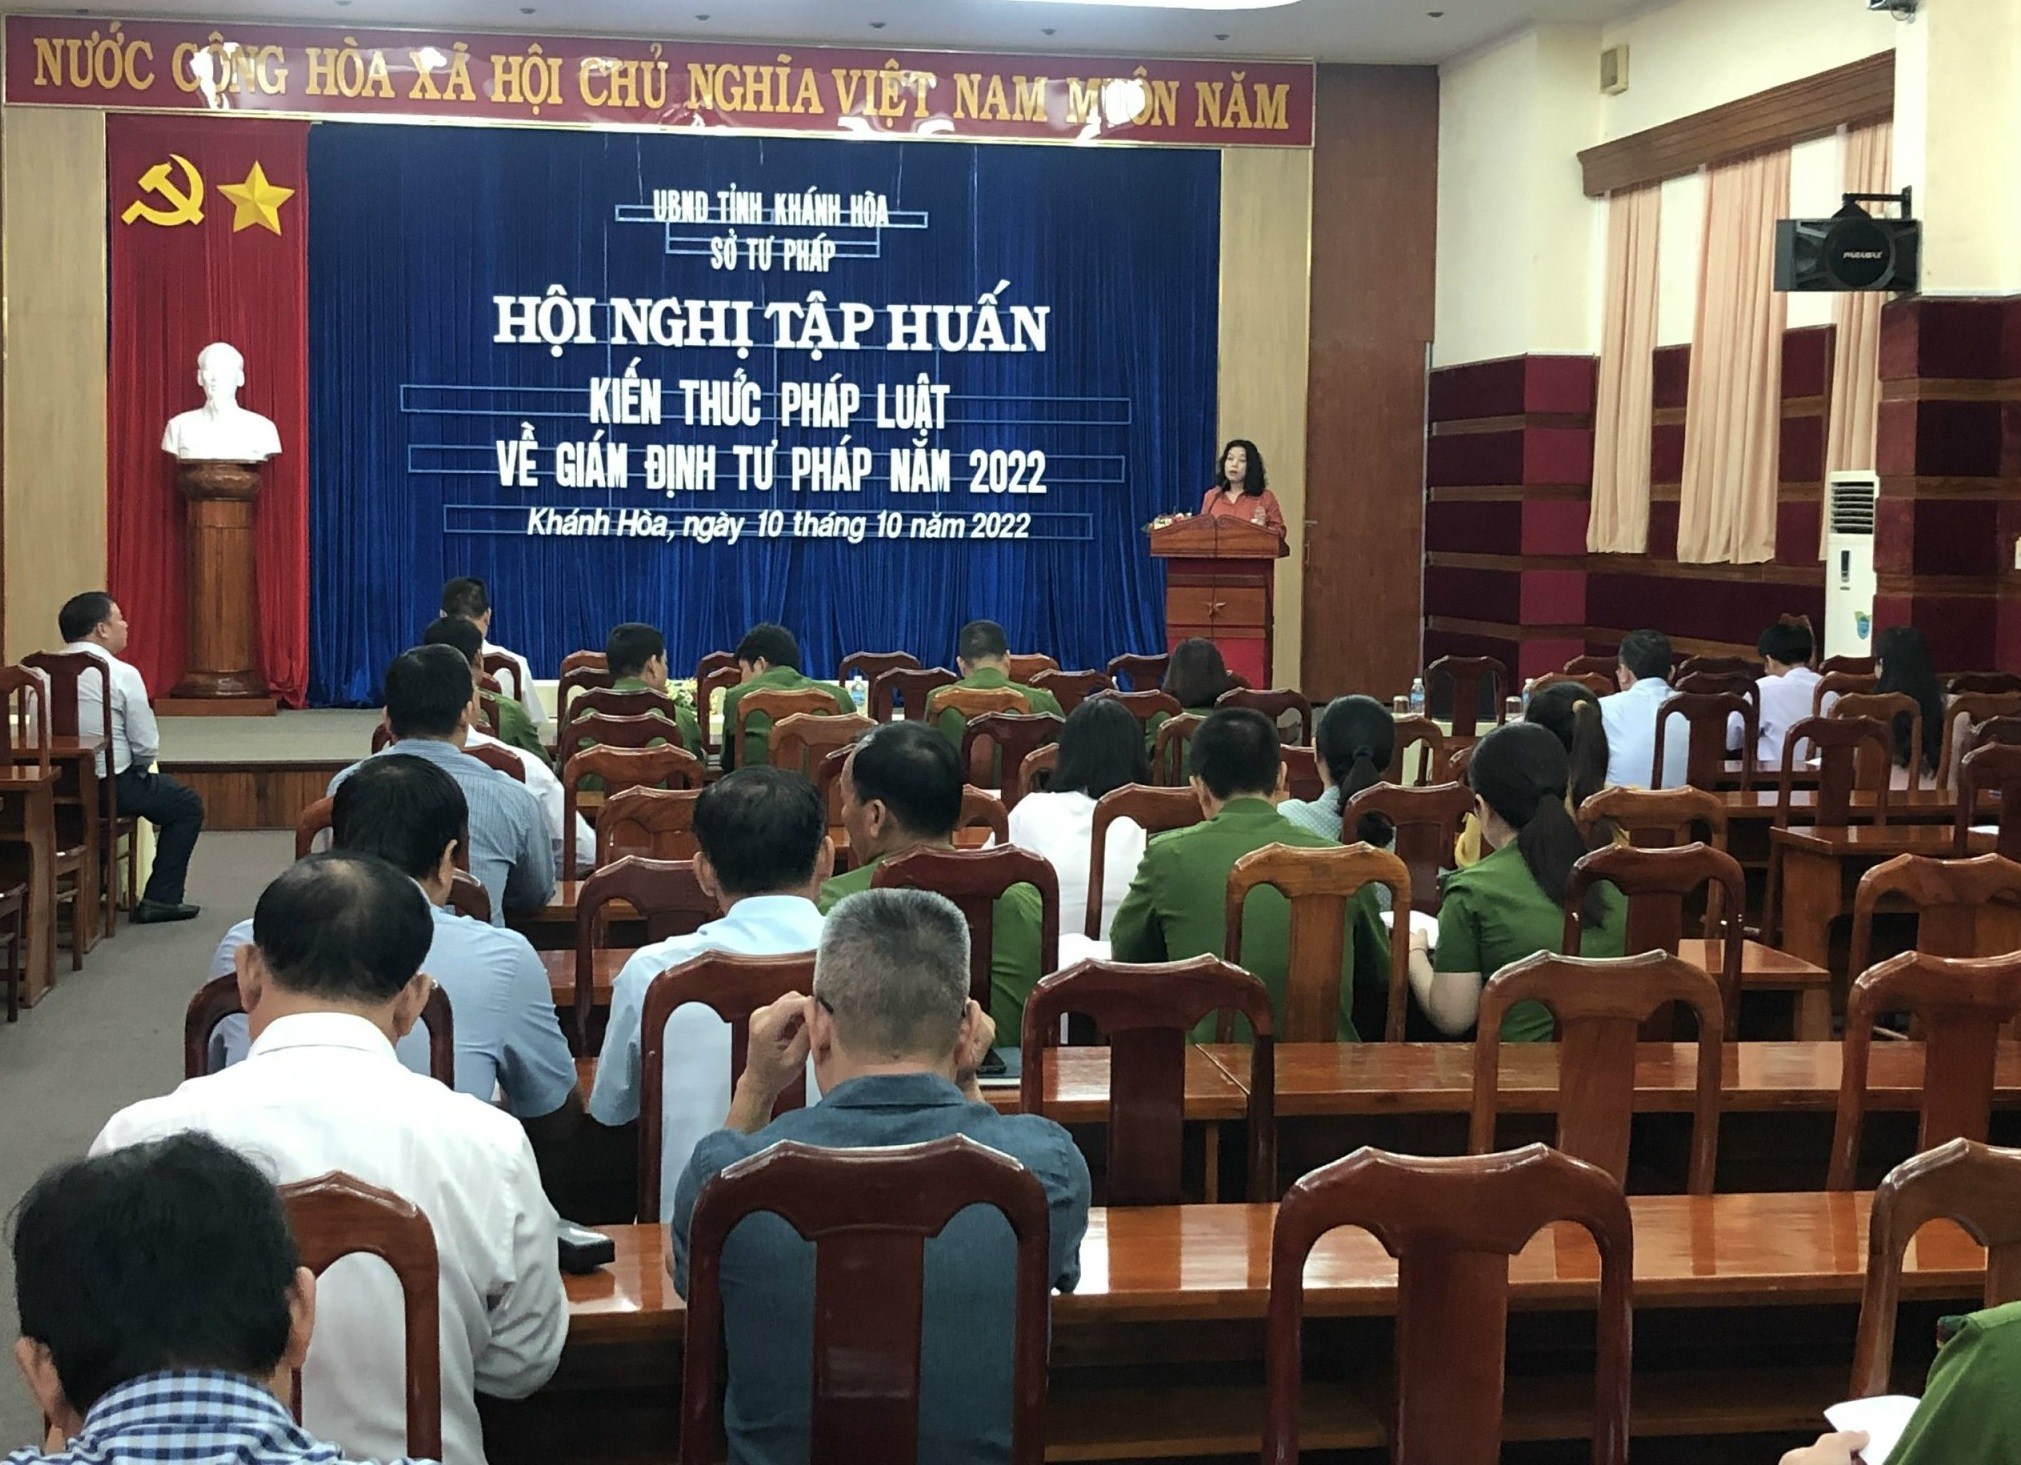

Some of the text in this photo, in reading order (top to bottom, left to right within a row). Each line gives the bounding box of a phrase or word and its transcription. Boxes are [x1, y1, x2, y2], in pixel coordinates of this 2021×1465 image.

[33, 20, 155, 91] NƯỚC
[172, 31, 289, 106] CỘNG
[305, 36, 395, 99] HÒA
[408, 41, 477, 101] XÃ
[490, 43, 564, 116] HỘI
[578, 43, 669, 109] CHỦ
[687, 53, 825, 114] NGHĨA
[831, 58, 937, 128] VIỆT
[953, 73, 1048, 122] NAM
[1195, 71, 1290, 130] NĂM
[653, 183, 890, 227] UBND TỈNH KHÁNH HÒA
[710, 228, 836, 272] SỞ TƯ PHÁP
[493, 279, 1051, 362] HỘI NGHỊ TẬP HUẤN
[589, 356, 951, 437] KIẾN THỨC PHÁP LUẬT
[496, 421, 1048, 499] VỀ GIÁM ĐỊNH TƯ PHÁP NĂM 2022
[526, 507, 1033, 546] Khánh Hòa, ngày 10 tháng 10 năm 2022
